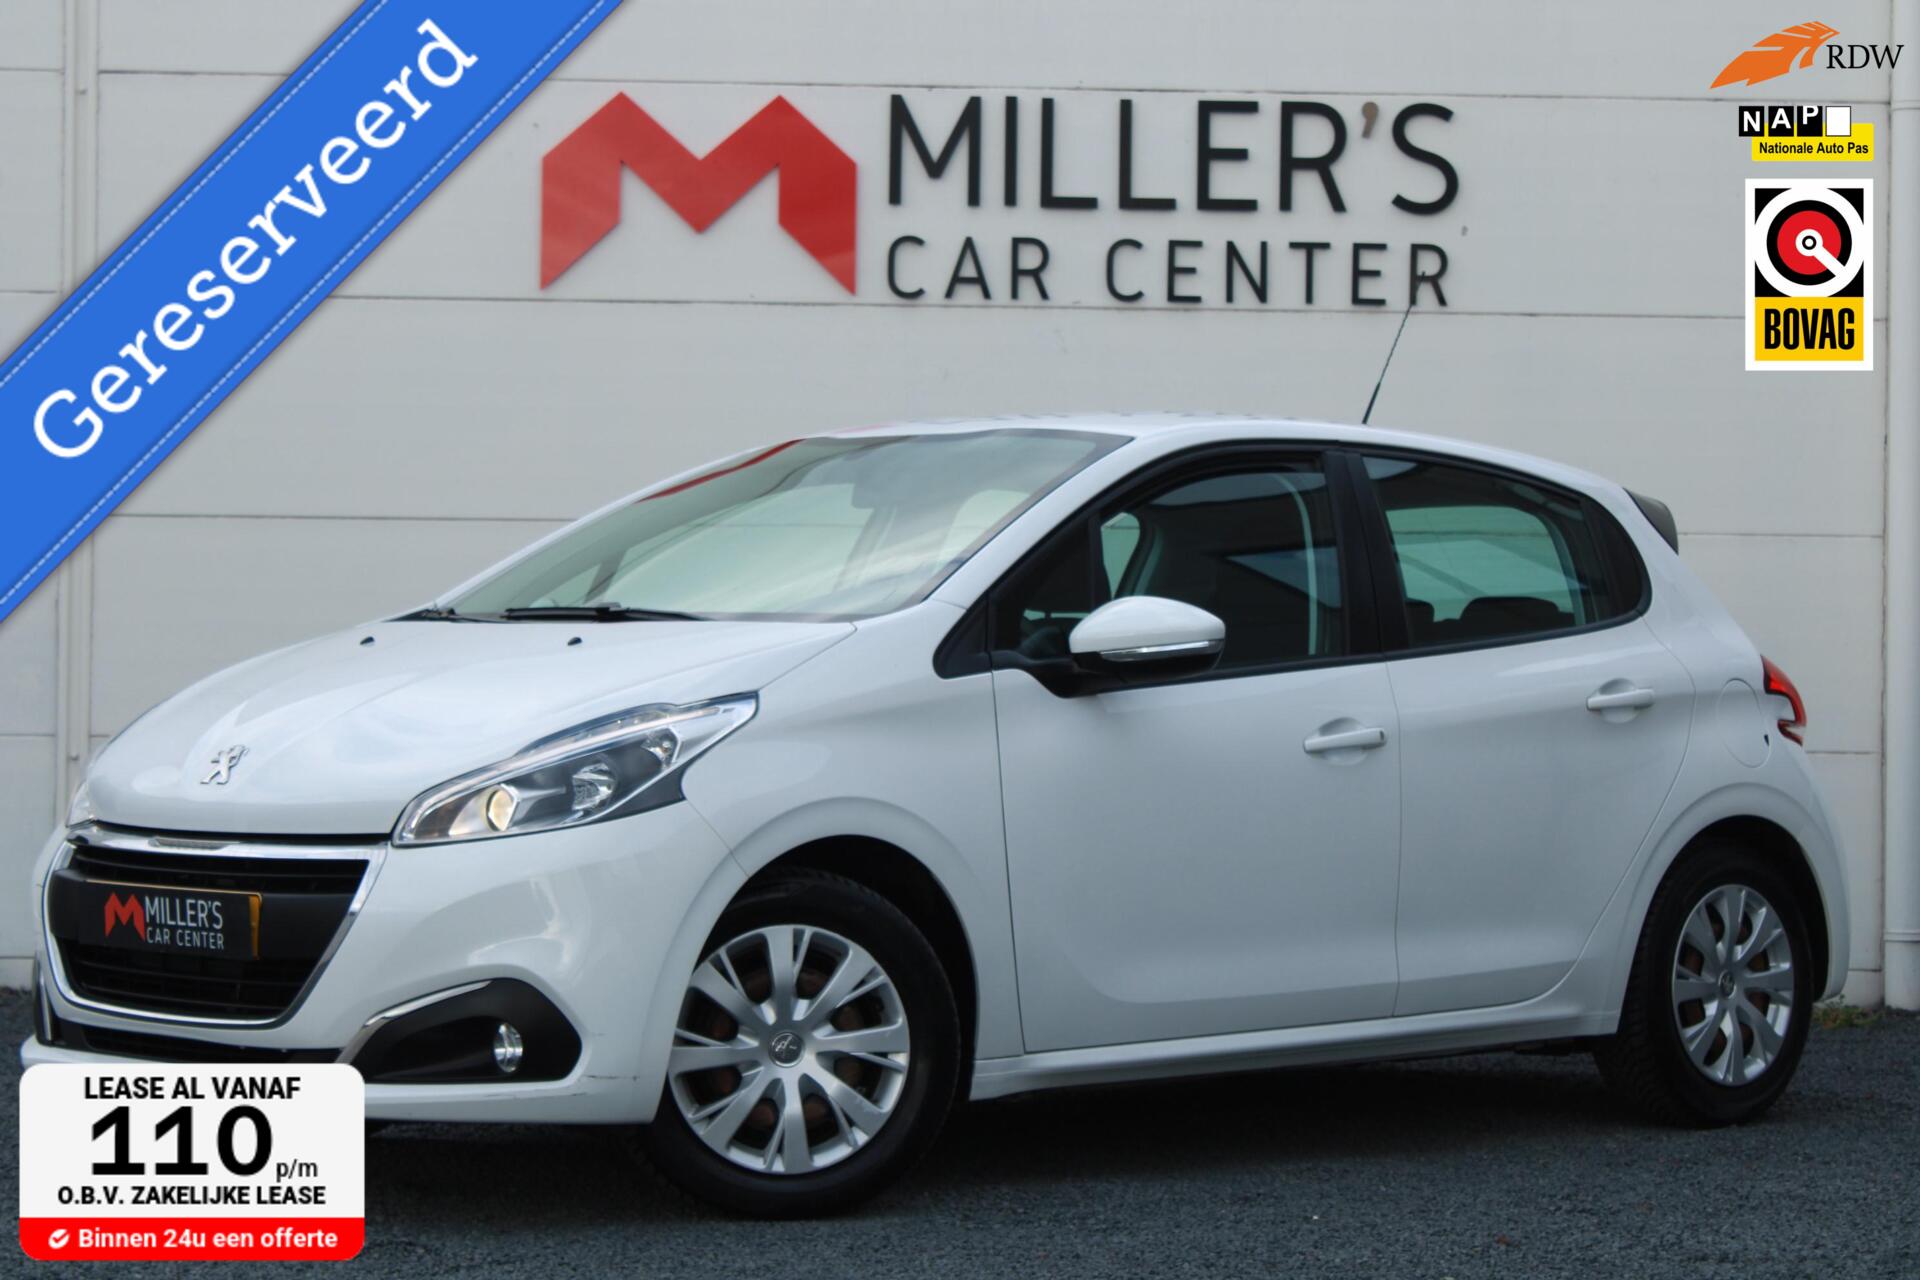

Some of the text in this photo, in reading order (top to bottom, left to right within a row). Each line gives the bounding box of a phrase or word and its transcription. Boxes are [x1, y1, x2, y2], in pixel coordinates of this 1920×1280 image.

[889, 93, 1460, 217] MILLER'S
[887, 235, 1451, 309] CAR CENTER
[145, 895, 224, 929] MILLER'S
[147, 927, 225, 950] CAR CENTER
